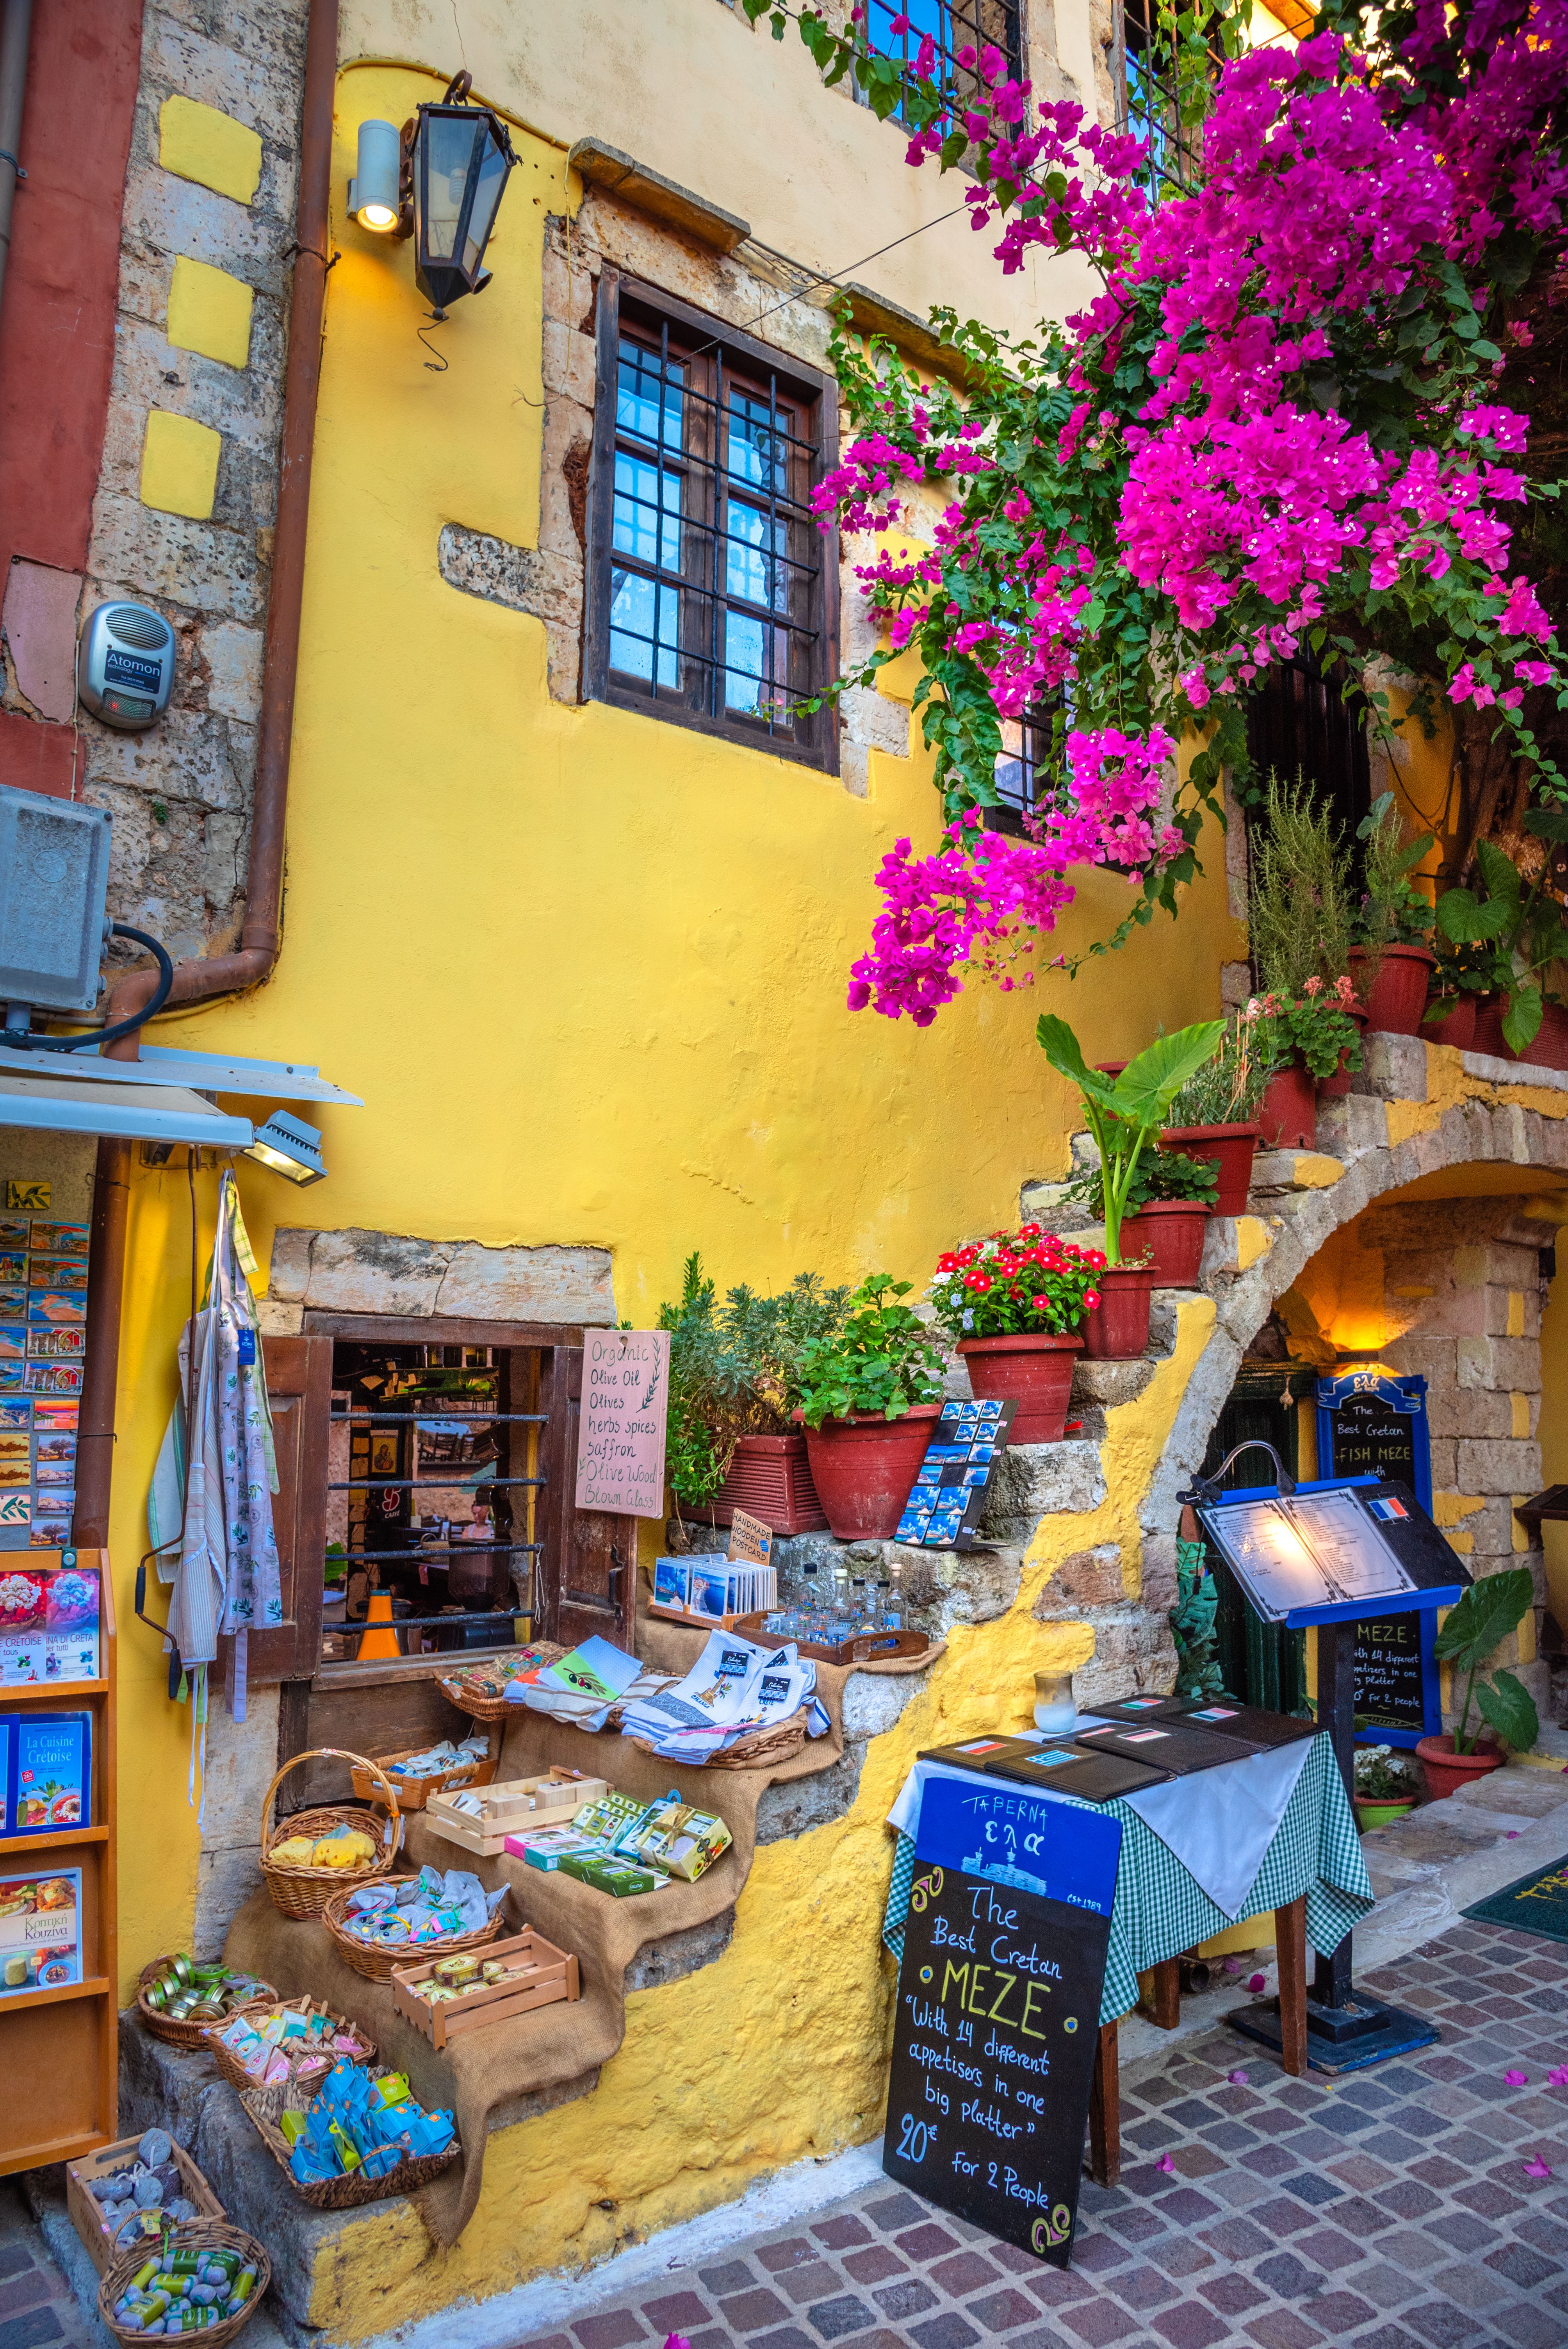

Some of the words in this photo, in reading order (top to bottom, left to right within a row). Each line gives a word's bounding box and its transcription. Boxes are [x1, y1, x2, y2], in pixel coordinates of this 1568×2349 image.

[107, 653, 160, 676] Atomon
[108, 663, 133, 674] technology
[592, 1340, 649, 1367] Organic
[591, 1369, 617, 1385] Olive
[623, 1369, 641, 1386] Oil
[1353, 1375, 1379, 1389] ελα
[590, 1392, 624, 1409] Olives
[1352, 1406, 1374, 1415] The
[588, 1415, 620, 1435] herbs
[625, 1421, 656, 1439] spices
[1337, 1424, 1360, 1435] Best
[1366, 1424, 1404, 1436] Cretan
[587, 1438, 636, 1461] saffron
[1340, 1447, 1371, 1462] FISH
[1378, 1447, 1410, 1460] MEZE
[587, 1460, 624, 1482] Olive
[627, 1463, 656, 1483] Wood
[1364, 1465, 1385, 1476] with
[585, 1484, 622, 1504] Blown
[627, 1489, 654, 1508] Glass
[732, 1525, 760, 1546] WOODEN
[733, 1512, 771, 1540] HANDMADE
[732, 1536, 766, 1561] POSTCARD
[5, 1636, 42, 1647] CRÉTOISE
[61, 1635, 68, 1643] DI
[70, 1633, 93, 1643] CRETA
[1358, 1624, 1407, 1643] MEZE
[1354, 1647, 1368, 1658] ith
[1371, 1649, 1382, 1661] 14
[1385, 1651, 1420, 1665] different
[1392, 1668, 1399, 1676] in
[1354, 1688, 1365, 1701] 0€
[1384, 1694, 1392, 1702] 2
[27, 1737, 37, 1748] La
[40, 1736, 74, 1748] Cuisine
[28, 1749, 71, 1764] Crétoise
[962, 1795, 1048, 1831] TABERNA
[985, 1821, 1044, 1855] ελα
[967, 1886, 1019, 1930] The
[1067, 1894, 1082, 1904] est
[1082, 1899, 1101, 1911] 1989
[25, 1913, 68, 1931] Κρητική
[25, 1925, 68, 1940] Κουζίνα
[930, 1915, 976, 1953] Best
[991, 1936, 1062, 1979] Cretan
[941, 1959, 1051, 2040] MEZE
[956, 2019, 974, 2047] 14
[984, 2028, 1050, 2075] different
[909, 2043, 982, 2087] appetisers
[995, 2074, 1009, 2096] in
[1017, 2090, 1044, 2115] one
[925, 2075, 949, 2115] big
[987, 2162, 998, 2188] 2
[1004, 2165, 1048, 2209] People
